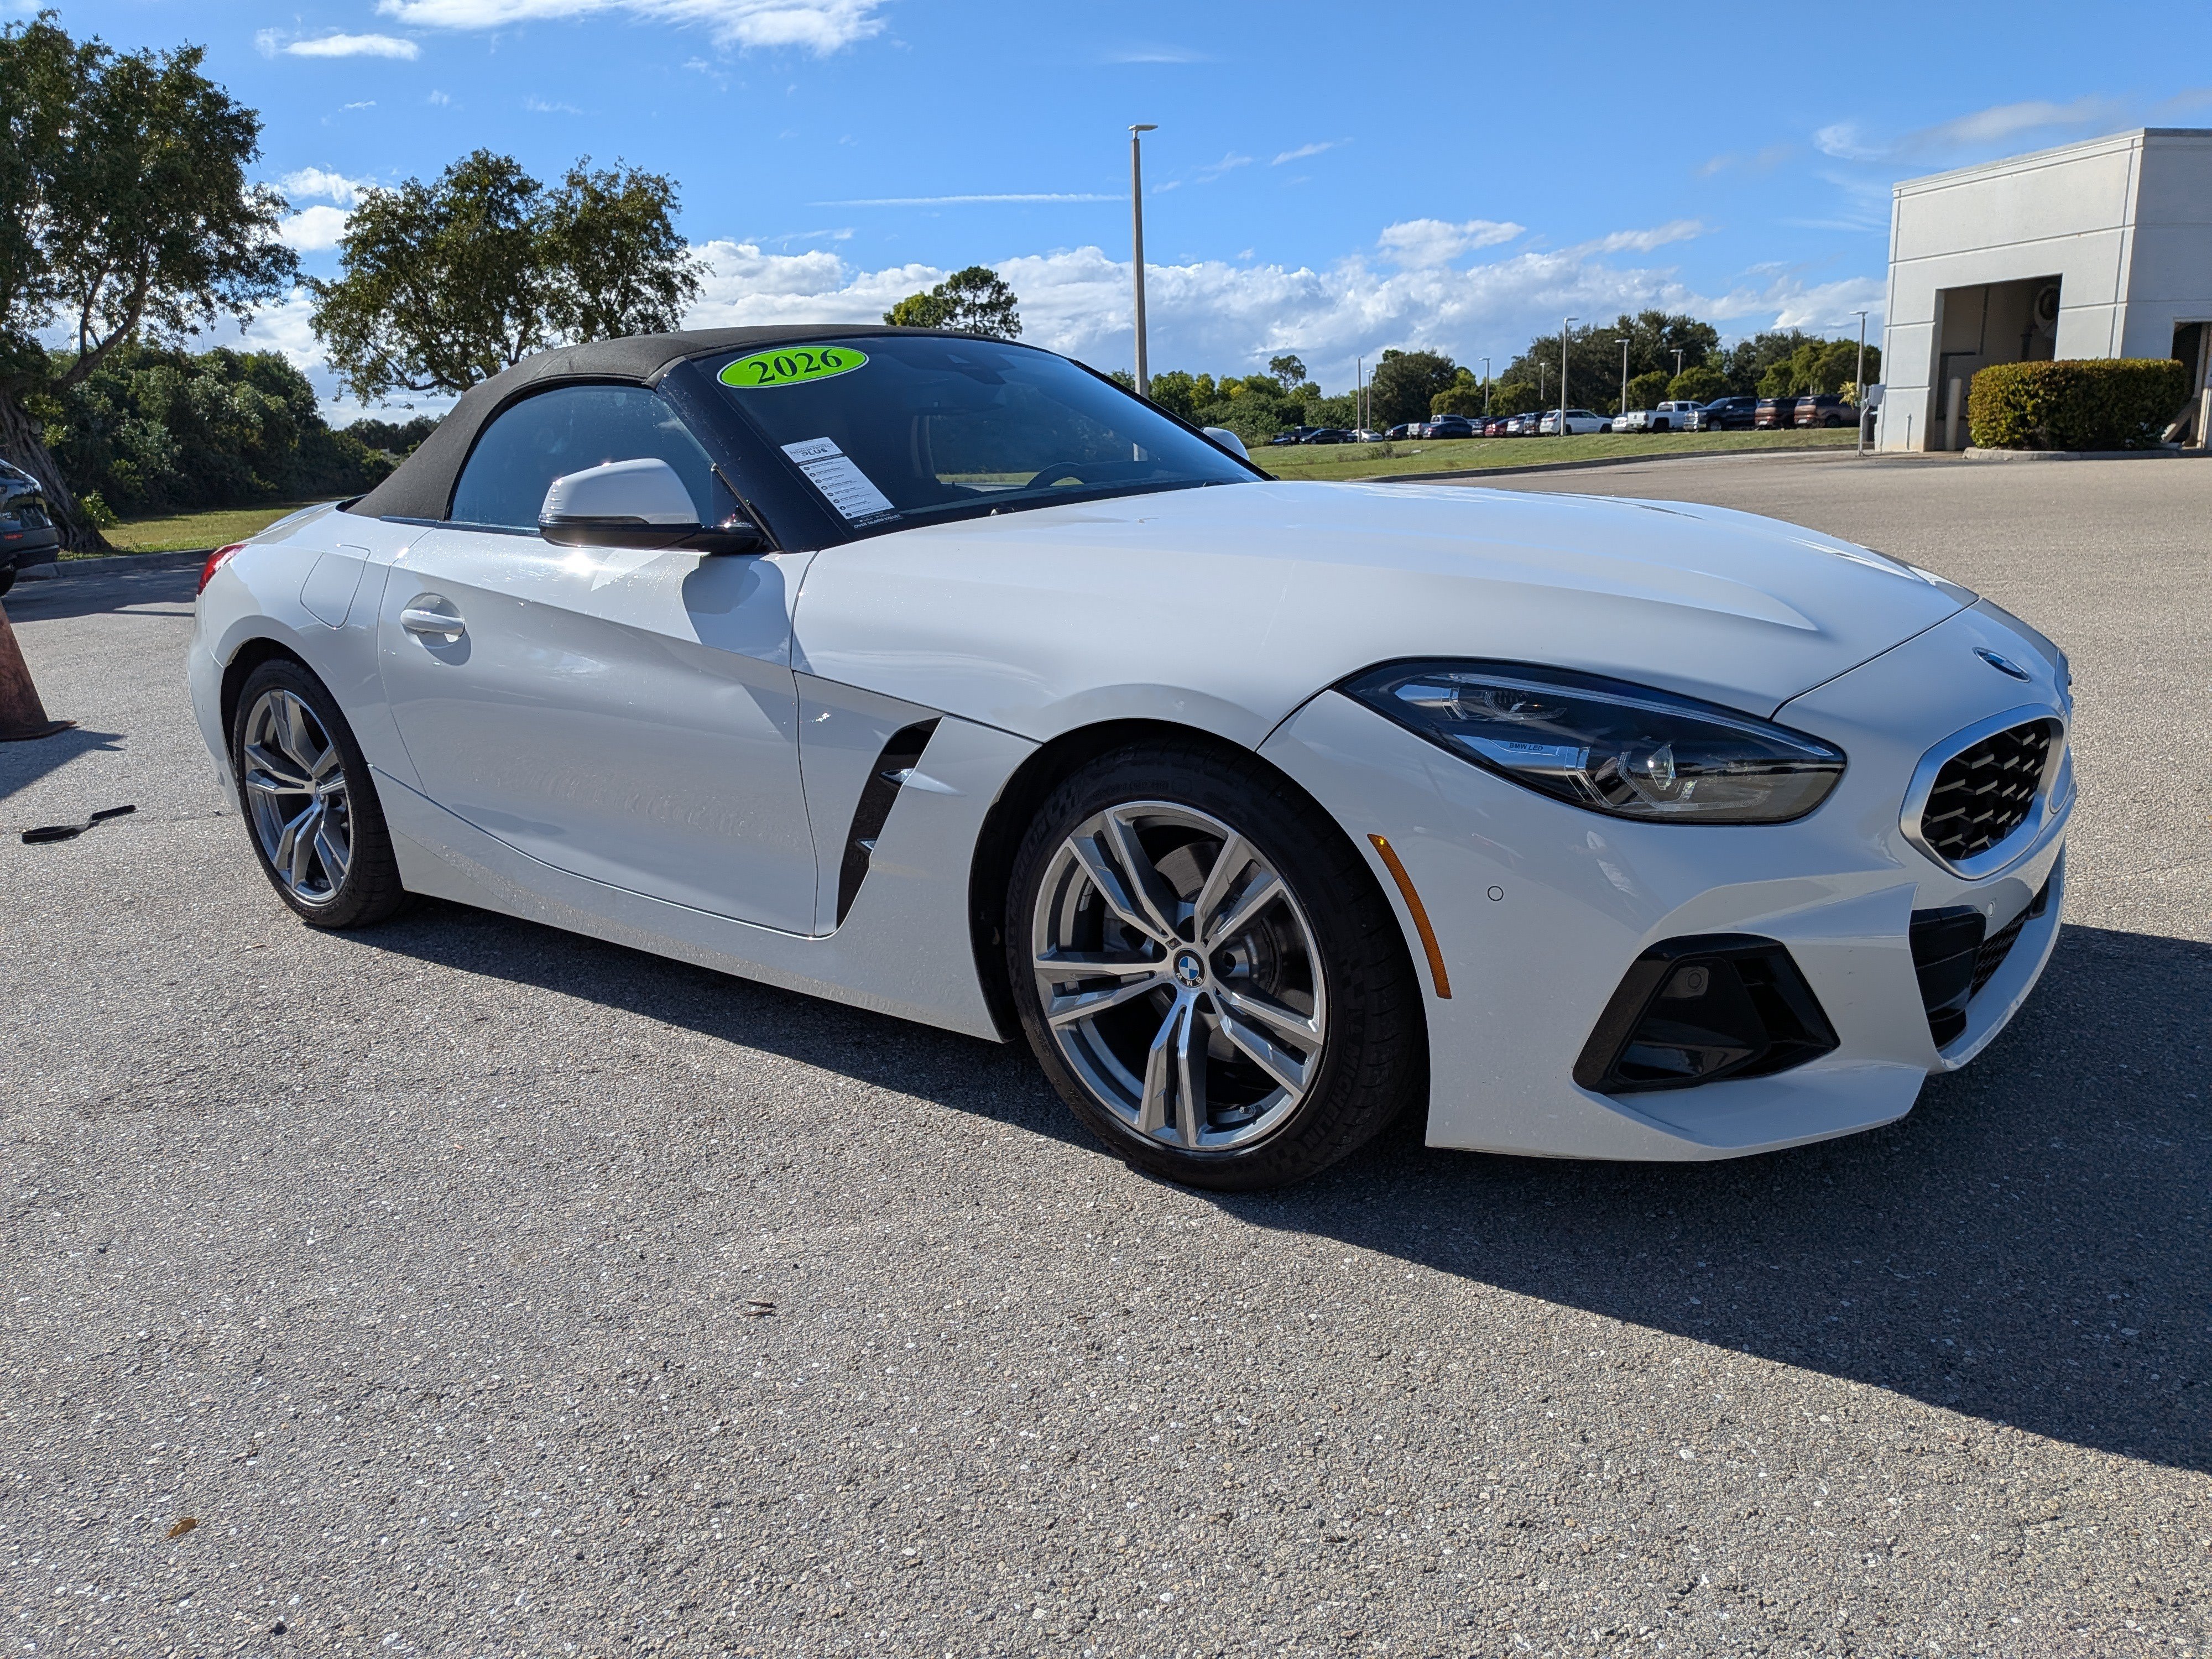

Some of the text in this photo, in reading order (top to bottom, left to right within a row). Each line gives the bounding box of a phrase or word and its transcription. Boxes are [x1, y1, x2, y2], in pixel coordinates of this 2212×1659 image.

[748, 348, 843, 384] 2026
[801, 448, 828, 457] PLUS
[812, 443, 833, 451] PROTECT
[1176, 972, 1203, 987] BMW
[1301, 1040, 1362, 1151] MICHELIN
